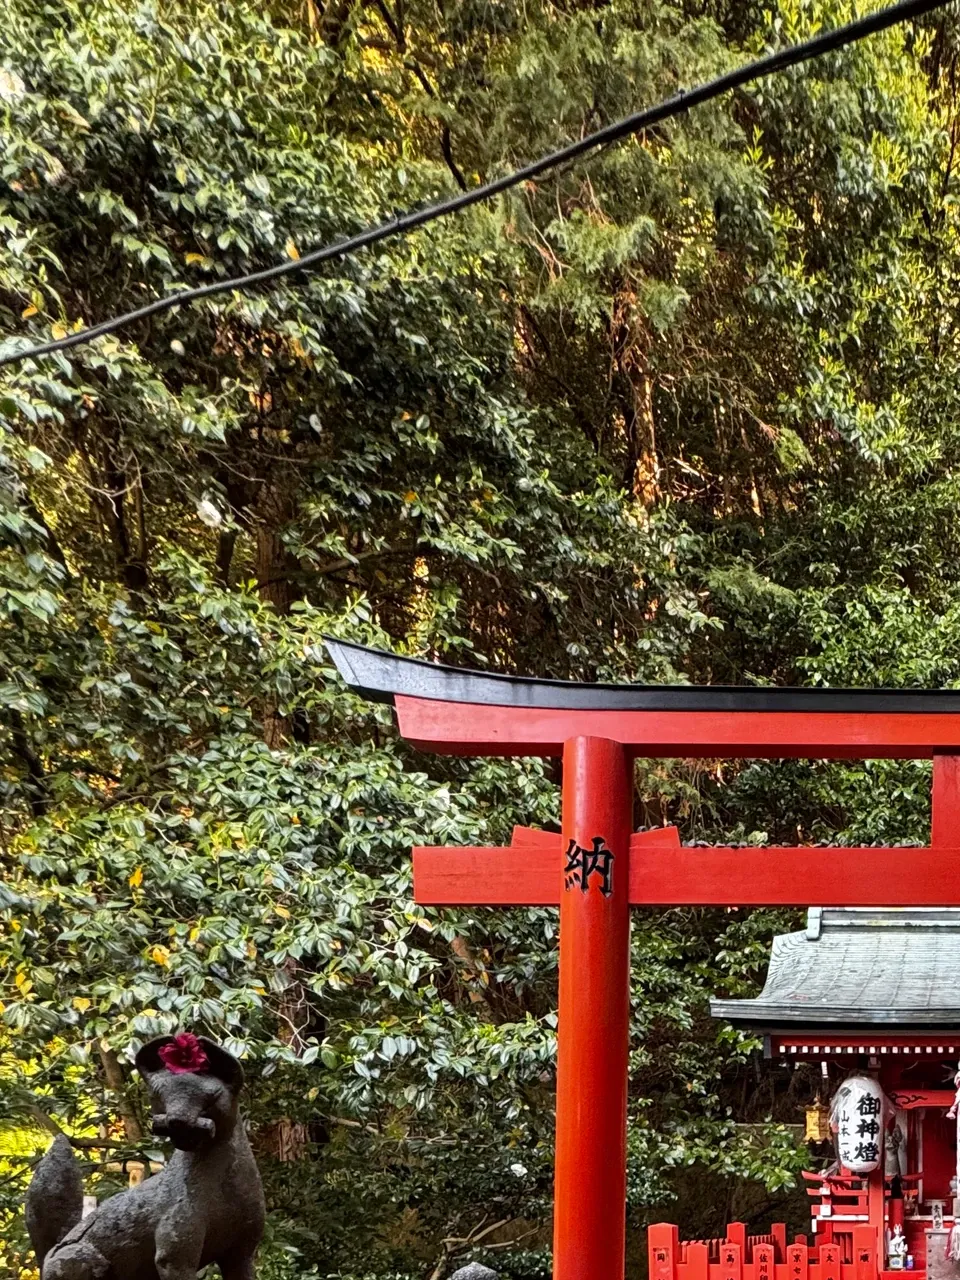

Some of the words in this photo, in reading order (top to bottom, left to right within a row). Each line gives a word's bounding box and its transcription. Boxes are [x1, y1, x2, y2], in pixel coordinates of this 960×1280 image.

[564, 836, 615, 898] 納
[853, 1092, 881, 1162] 御神燈
